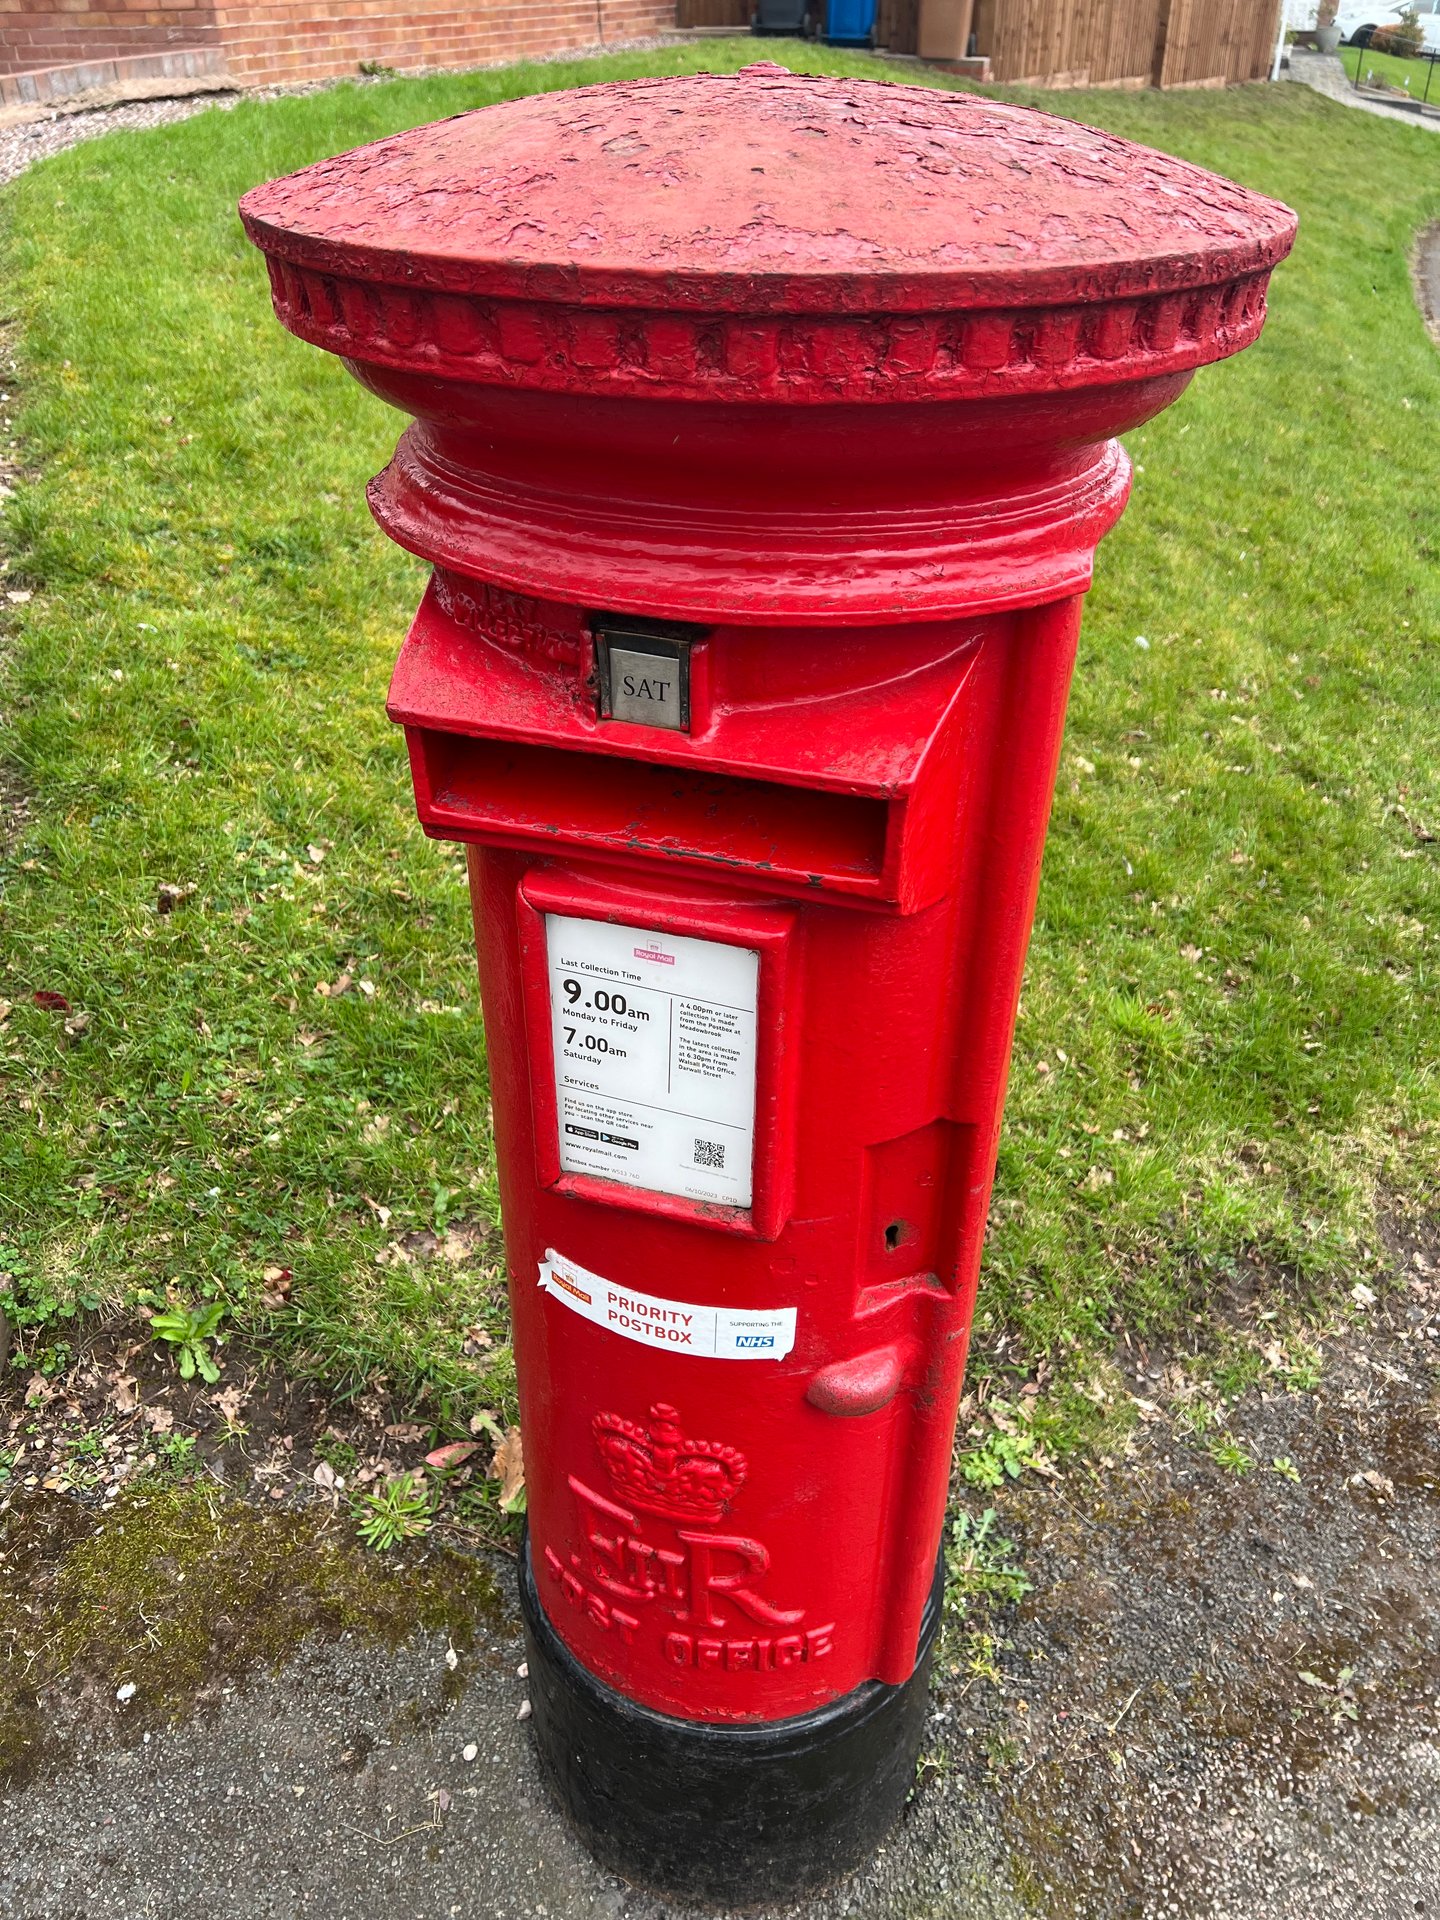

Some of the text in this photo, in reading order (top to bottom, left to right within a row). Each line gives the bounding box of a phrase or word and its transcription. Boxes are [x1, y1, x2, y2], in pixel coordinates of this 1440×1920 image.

[623, 675, 670, 702] SAT
[635, 949, 673, 964] Royal Mail
[561, 957, 641, 981] Last Collection Time
[563, 979, 650, 1021] 9.00am
[680, 1010, 709, 1020] collection
[686, 1004, 713, 1014] 4.00pm
[562, 1007, 638, 1032] Monday to Friday
[680, 1016, 694, 1024] from
[708, 1023, 732, 1032] Postbox
[680, 1024, 722, 1037] Meadowbrook
[563, 1026, 627, 1058] 7.00am
[692, 1040, 710, 1048] latest
[711, 1045, 740, 1056] collection
[563, 1048, 602, 1066] Saturday
[678, 1058, 700, 1067] Walsall
[686, 1052, 712, 1063] 6.30pm
[712, 1059, 728, 1067] from
[720, 1054, 738, 1062] made
[678, 1064, 722, 1079] Darwall Street
[564, 1075, 600, 1090] Services
[564, 1097, 576, 1105] Find
[618, 1110, 633, 1118] store
[575, 1106, 598, 1117] locating
[598, 1112, 614, 1120] other
[616, 1116, 639, 1126] services
[616, 1122, 629, 1130] code
[565, 1142, 628, 1161] www.royalmail.com
[566, 1156, 587, 1166] Postbox
[588, 1163, 610, 1172] number
[552, 1273, 590, 1303] Royal Mail
[608, 1292, 693, 1326] PRIORITY
[608, 1309, 693, 1345] POSTBOX
[737, 1337, 773, 1347] NHS
[664, 1621, 837, 1672] OFFICE
